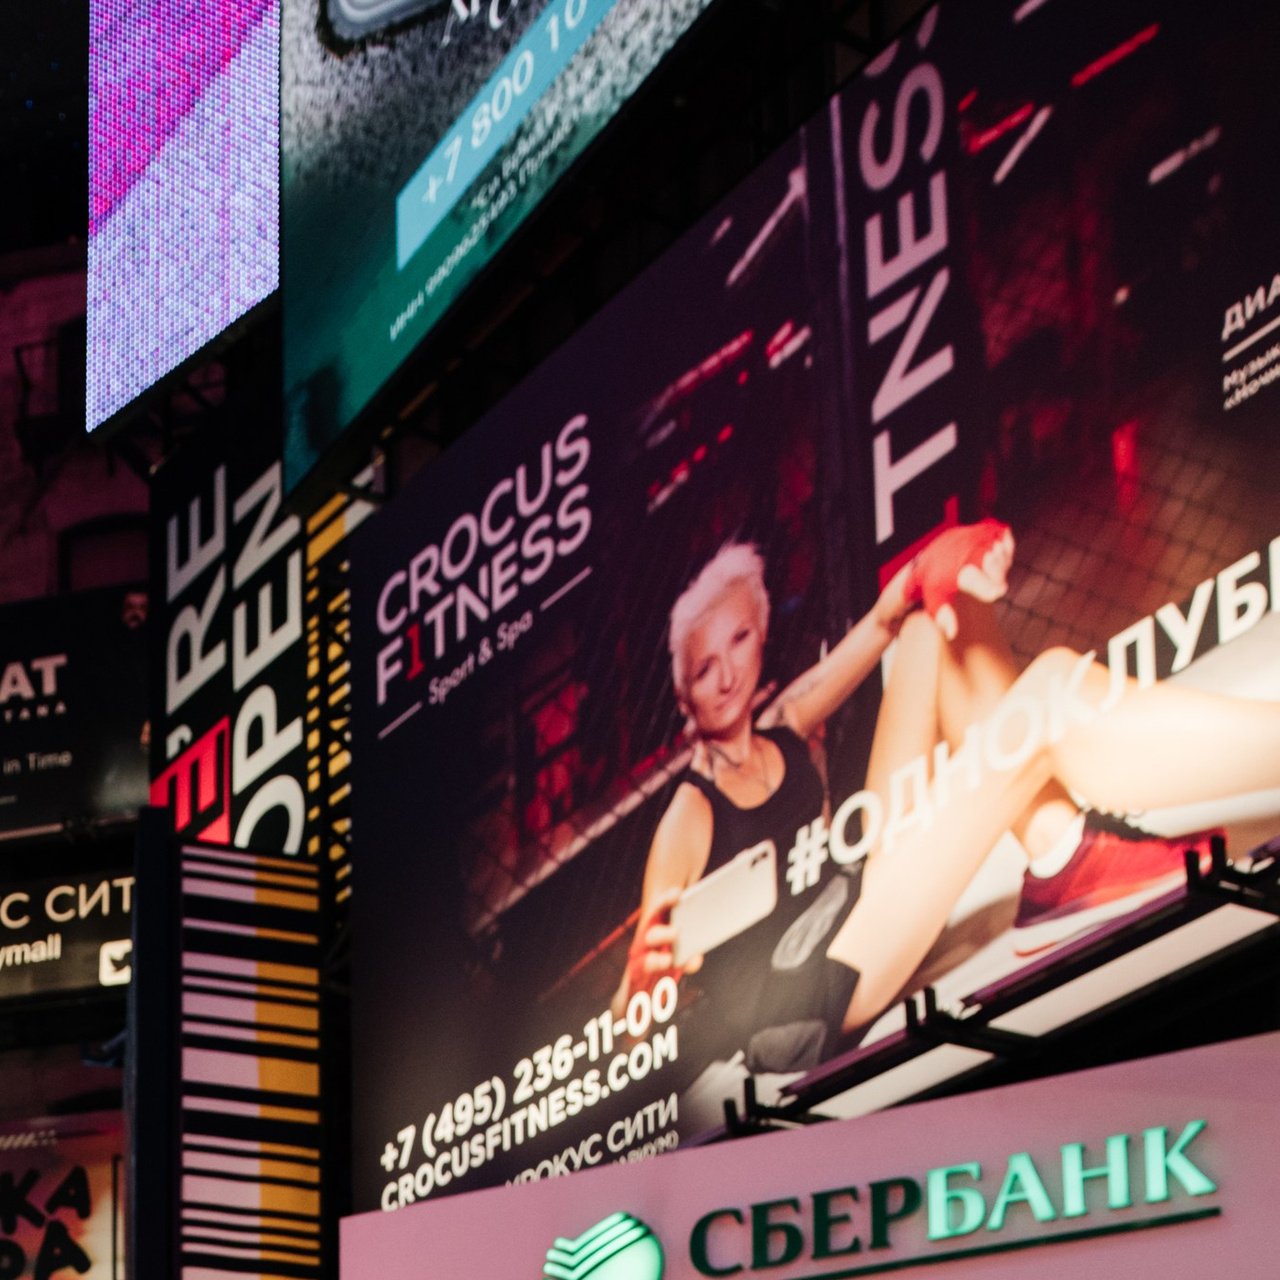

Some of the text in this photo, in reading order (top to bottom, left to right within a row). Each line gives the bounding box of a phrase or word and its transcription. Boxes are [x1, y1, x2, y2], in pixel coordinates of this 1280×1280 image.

[421, 134, 463, 204] +7
[471, 49, 535, 148] 800
[376, 413, 591, 636] CROCUS
[428, 610, 534, 707] Sport & Spa
[3, 757, 21, 775] in
[26, 750, 72, 772] Time
[45, 876, 136, 923] СИТ
[380, 976, 679, 1172] +7 (495) 236-11-00
[381, 1024, 679, 1213] CROCUSFITNESS.COM
[606, 1091, 678, 1153] СИТИ
[688, 1118, 1217, 1279] СБЕРБАНК
